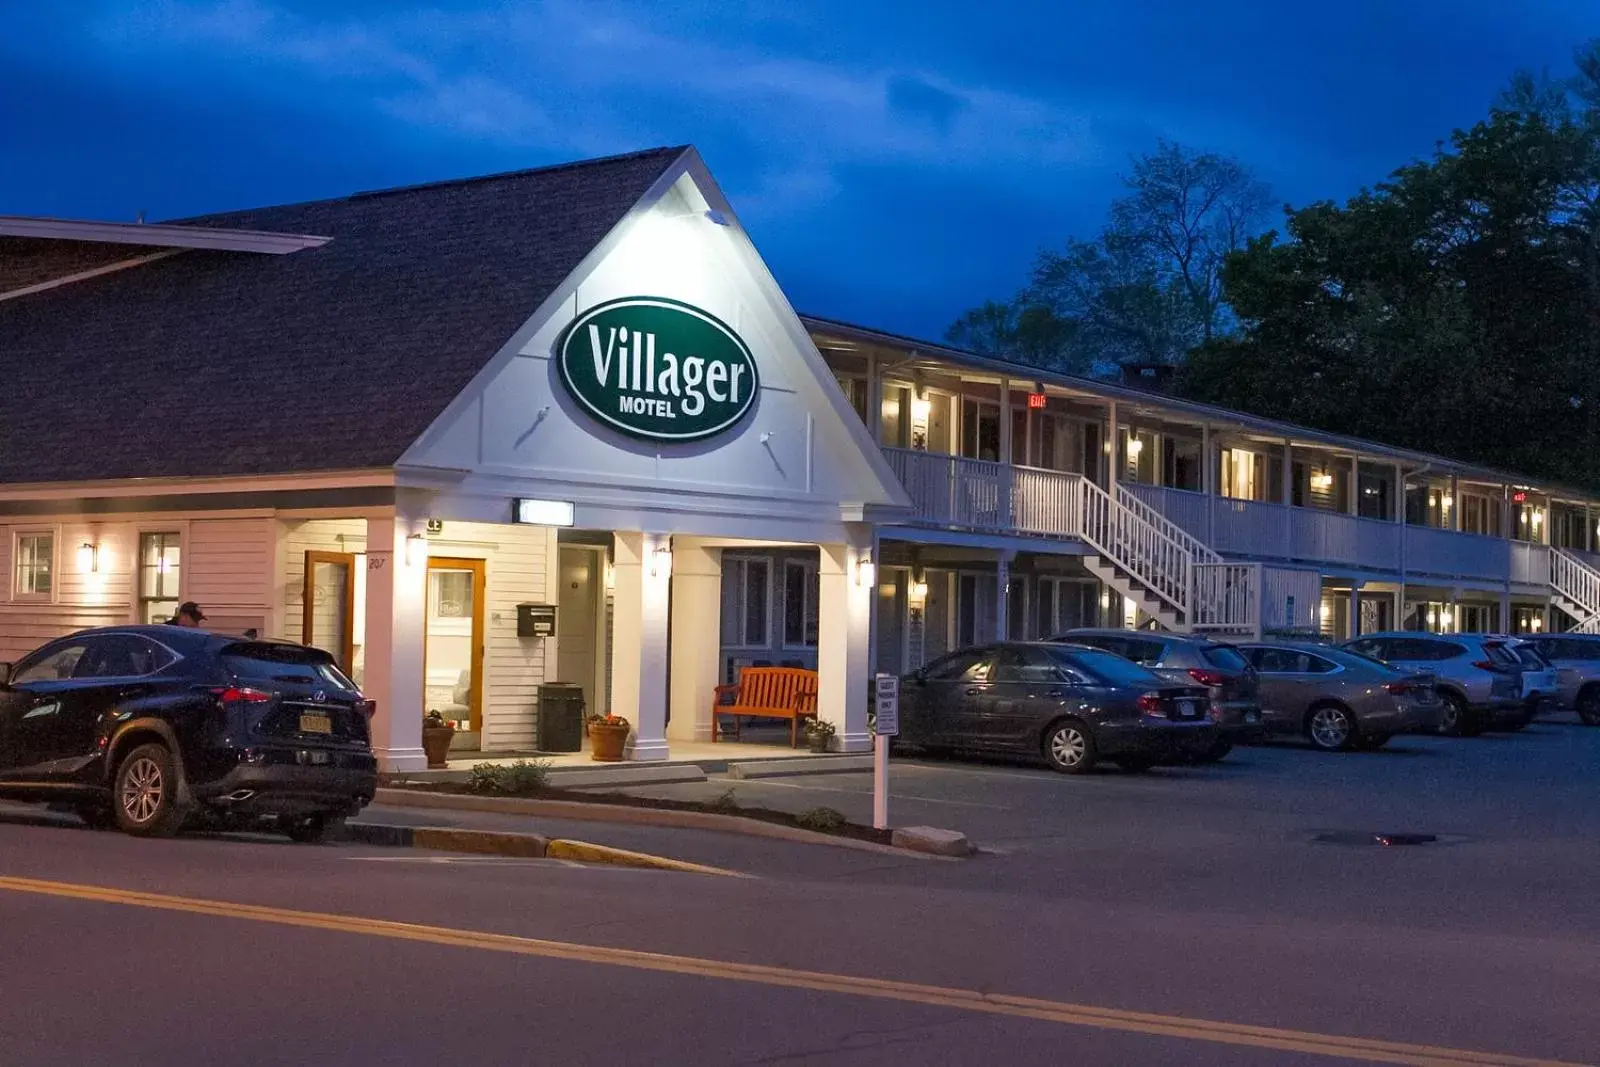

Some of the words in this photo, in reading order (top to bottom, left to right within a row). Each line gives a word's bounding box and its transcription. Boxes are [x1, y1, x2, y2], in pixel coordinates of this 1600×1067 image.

[588, 324, 745, 416] Villager
[619, 395, 676, 418] MOTEL
[368, 558, 385, 569] 207
